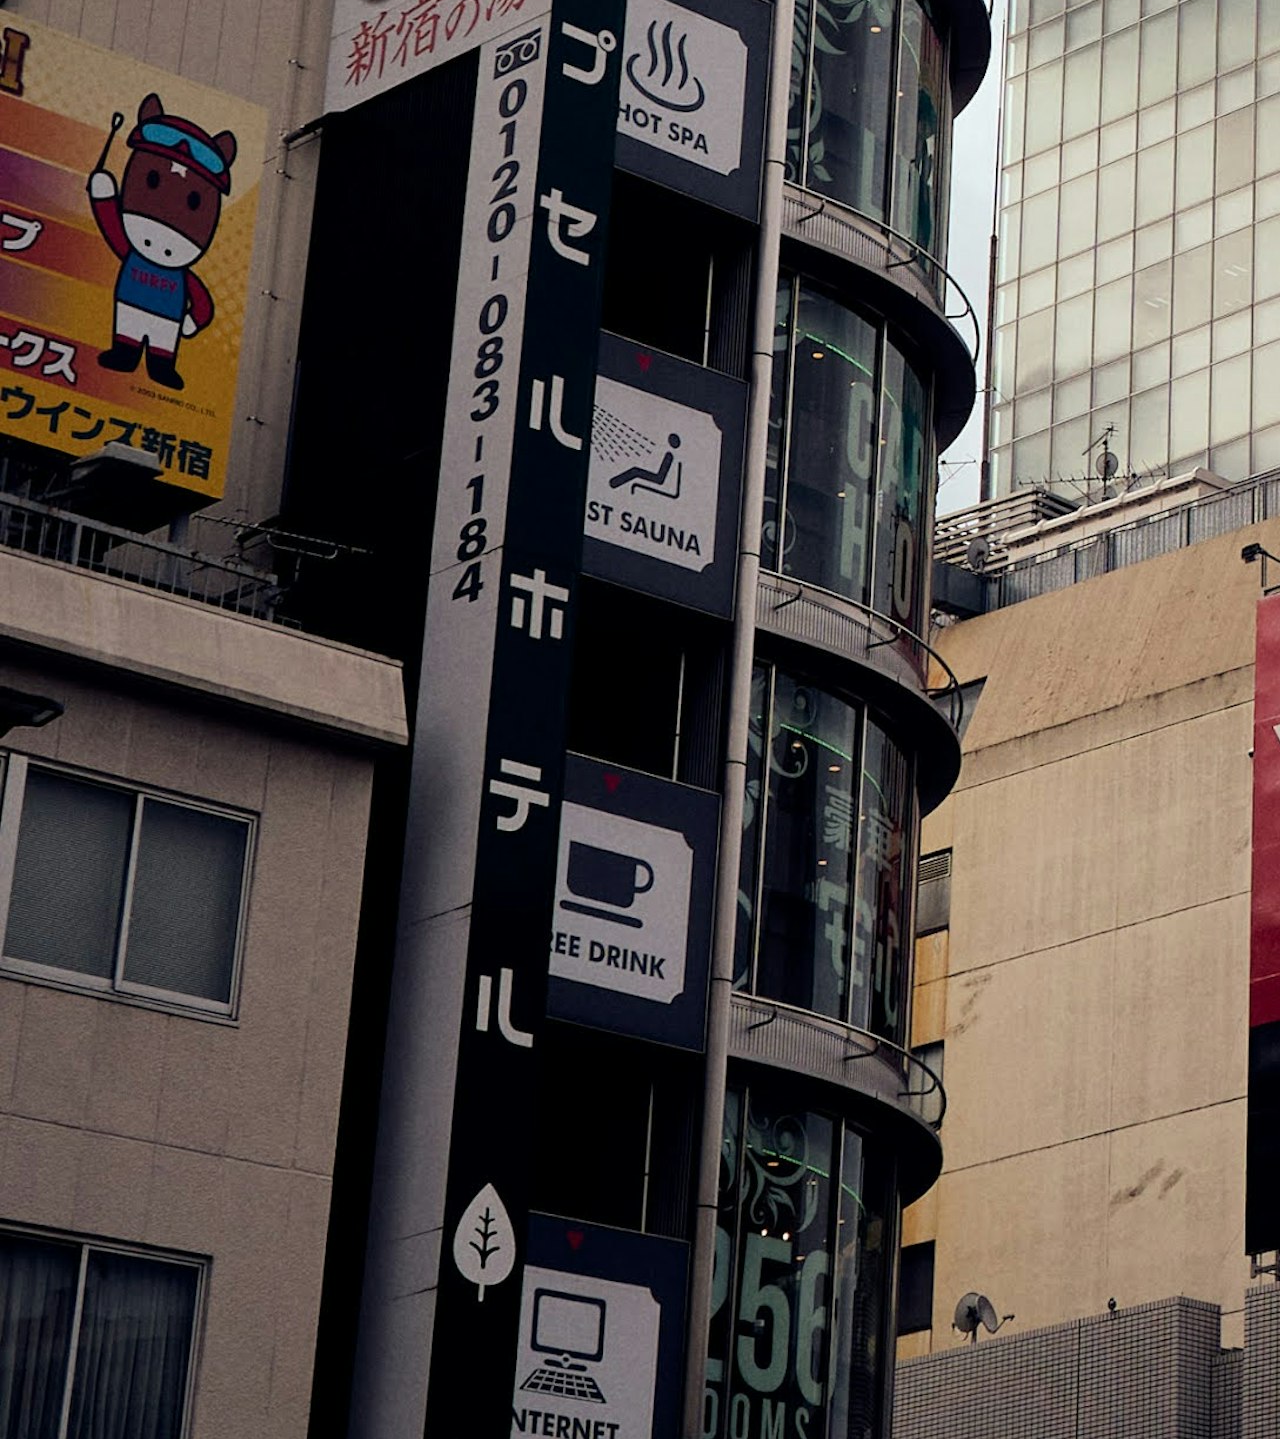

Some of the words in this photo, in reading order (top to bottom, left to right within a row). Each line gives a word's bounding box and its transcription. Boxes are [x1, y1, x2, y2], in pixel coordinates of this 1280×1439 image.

[667, 123, 709, 156] SPA
[130, 264, 180, 298] TURFY
[619, 508, 702, 557] SAUNA
[588, 939, 667, 982] DRINK
